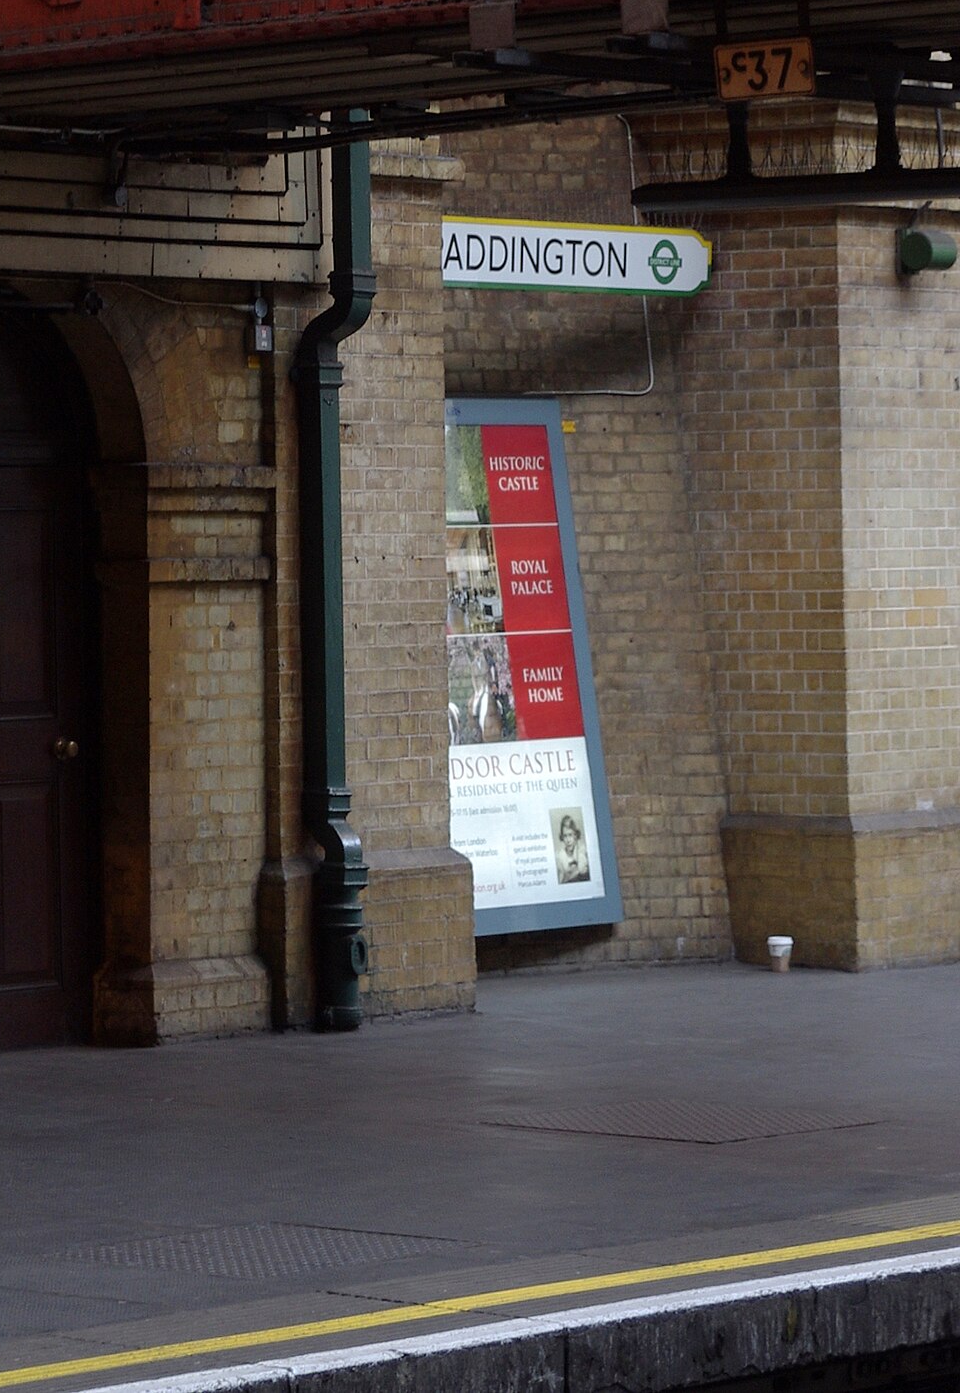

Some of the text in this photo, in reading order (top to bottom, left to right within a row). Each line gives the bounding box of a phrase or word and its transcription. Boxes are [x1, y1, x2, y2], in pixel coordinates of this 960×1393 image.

[442, 233, 627, 278] ADDINGTON
[489, 456, 545, 471] HISTORIC
[498, 475, 539, 492] CASTLE
[511, 559, 549, 575] ROYAL
[511, 579, 553, 595] PALACE
[522, 666, 564, 683] FAMILY
[528, 687, 564, 703] HOME
[450, 749, 577, 780] DSOR CASTLE
[456, 782, 508, 798] RESIDENCE
[510, 781, 523, 794] OF
[526, 779, 545, 793] THE
[546, 777, 578, 793] QUEEN
